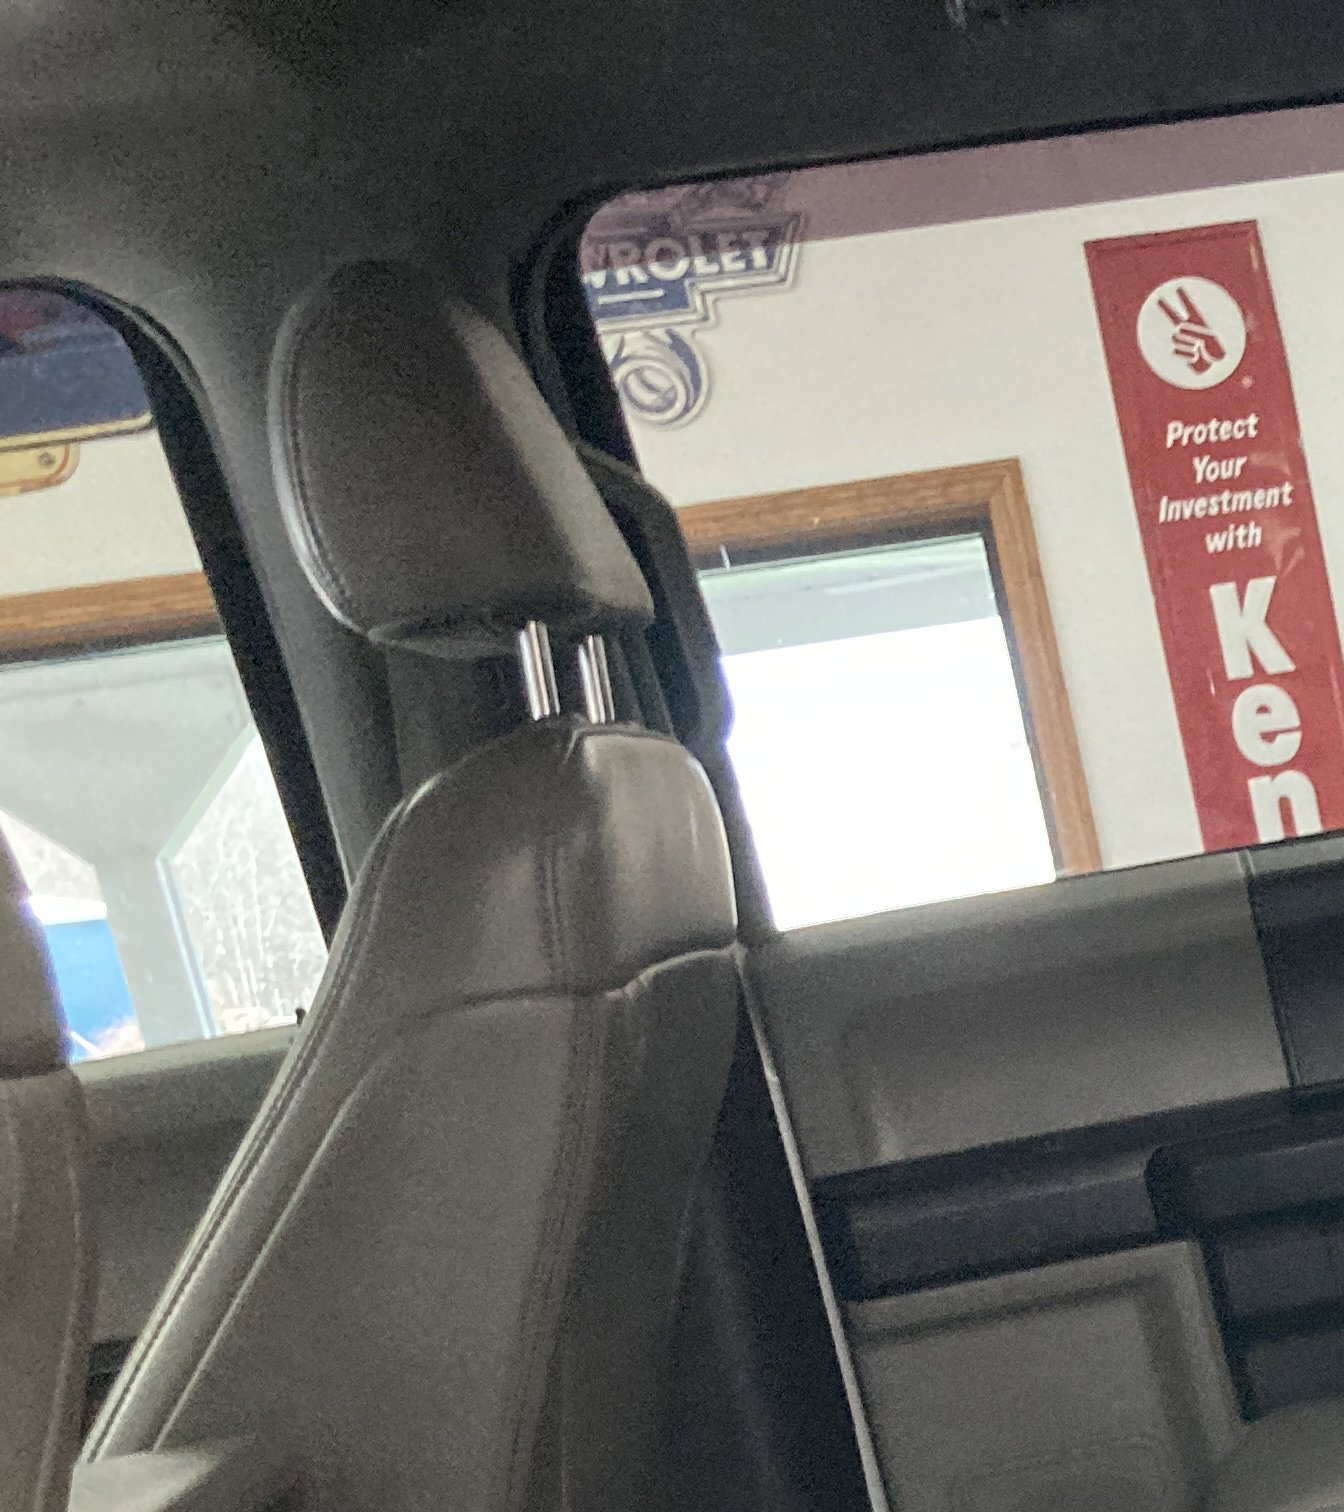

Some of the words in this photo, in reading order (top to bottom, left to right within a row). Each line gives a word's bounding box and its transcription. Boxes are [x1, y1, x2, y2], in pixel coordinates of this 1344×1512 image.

[1166, 413, 1260, 448] Protect
[1192, 455, 1248, 484] Your
[1159, 481, 1294, 523] Investment
[1205, 521, 1262, 554] with
[1209, 575, 1323, 844] Ken
